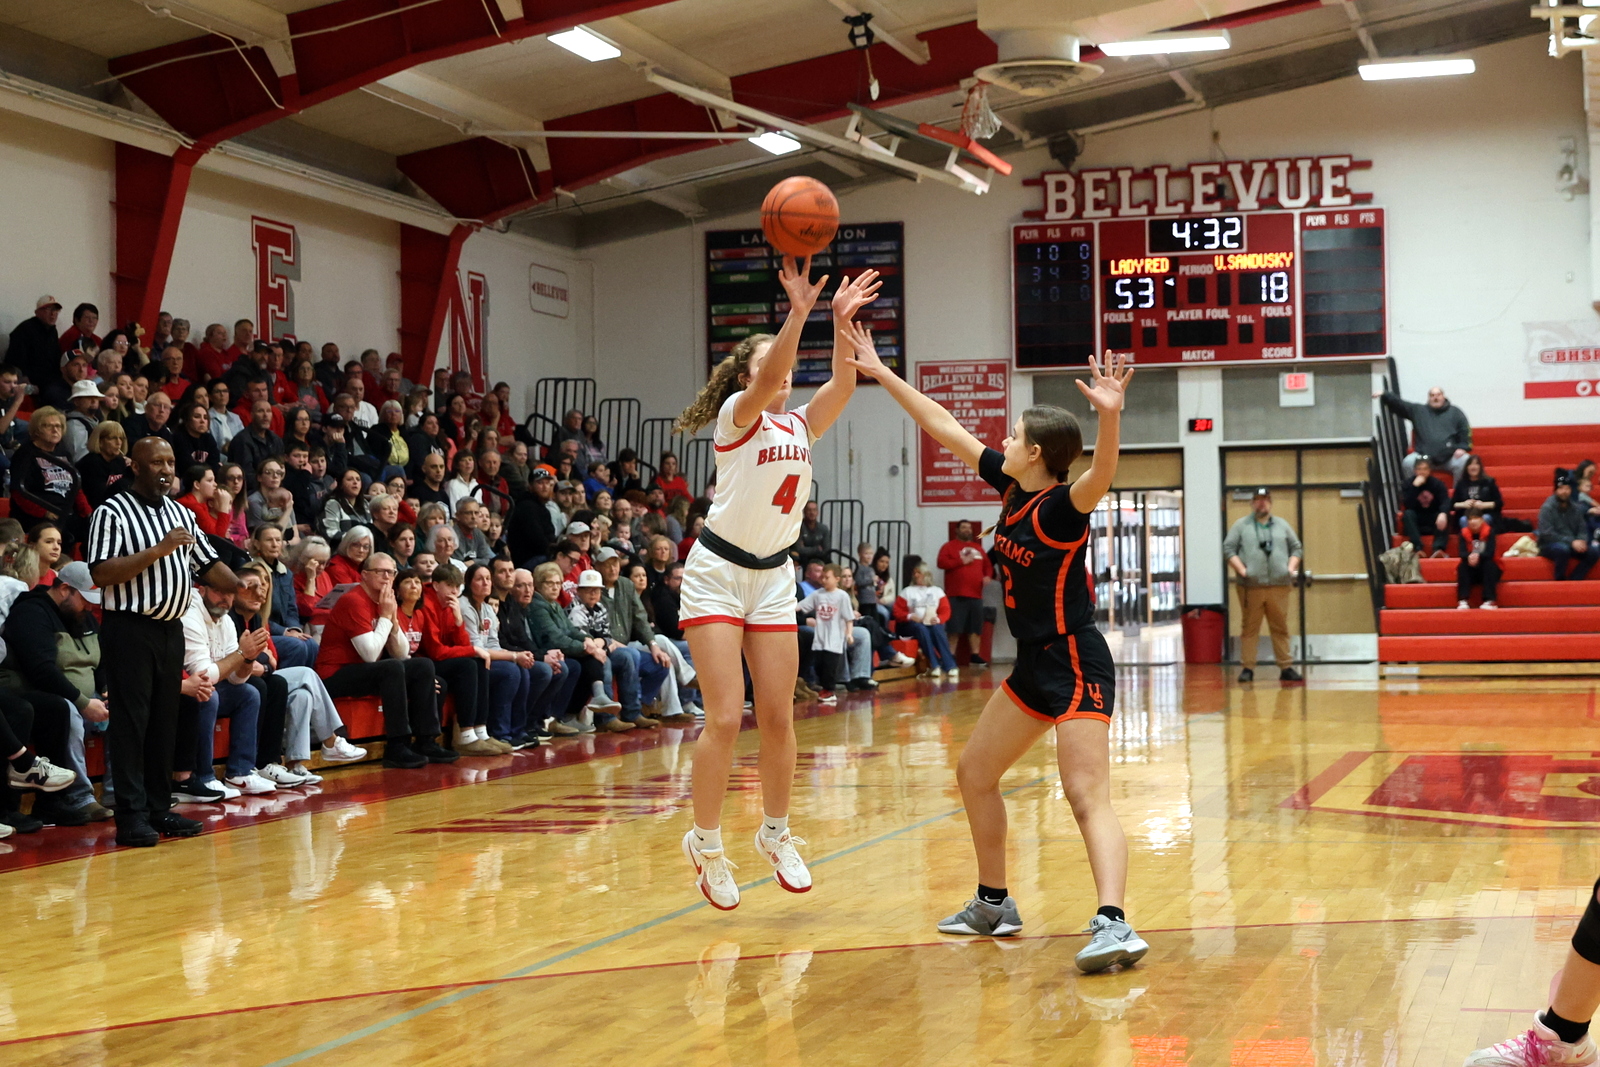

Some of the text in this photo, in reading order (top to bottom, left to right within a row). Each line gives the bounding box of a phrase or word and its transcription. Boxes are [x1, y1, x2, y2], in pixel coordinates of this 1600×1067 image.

[1044, 157, 1352, 219] BELLEVUE
[1305, 212, 1376, 227] PLYR FLS PTS
[1020, 227, 1086, 240] PLYR FLS PTS
[1172, 217, 1241, 249] 4:32
[1049, 245, 1059, 261] 0
[1080, 243, 1090, 260] 0
[1179, 264, 1214, 275] PERIOD
[1214, 251, 1294, 272] U.SANDUSKY
[1115, 277, 1154, 309] 53
[1260, 271, 1288, 303] 18
[1103, 312, 1134, 323] FOULS
[1167, 308, 1231, 321] PLAYER FOUL
[1261, 306, 1292, 318] FOULS
[1182, 349, 1215, 361] MATCH
[1261, 346, 1294, 359] SCORE
[922, 373, 1005, 392] BELLEVUE HS
[771, 474, 800, 514] 4
